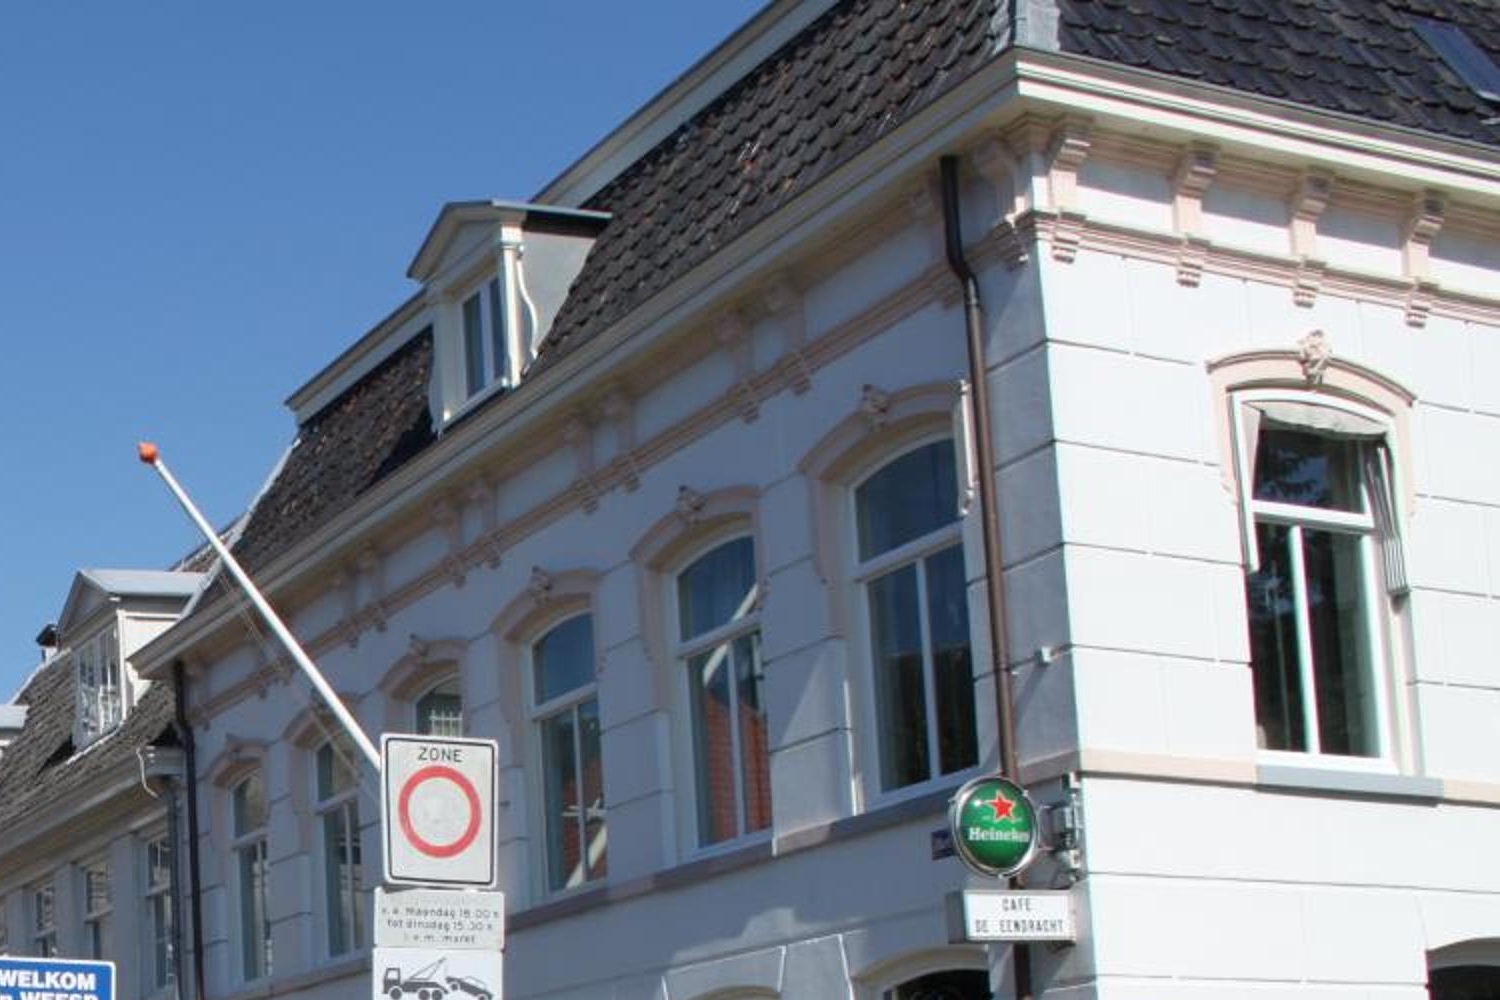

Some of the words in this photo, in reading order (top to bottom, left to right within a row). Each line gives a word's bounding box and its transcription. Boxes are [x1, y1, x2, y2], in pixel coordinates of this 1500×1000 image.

[417, 747, 463, 762] ZONE
[1002, 898, 1033, 911] CAFE
[387, 919, 403, 929] tot
[407, 919, 451, 932] dinsdag
